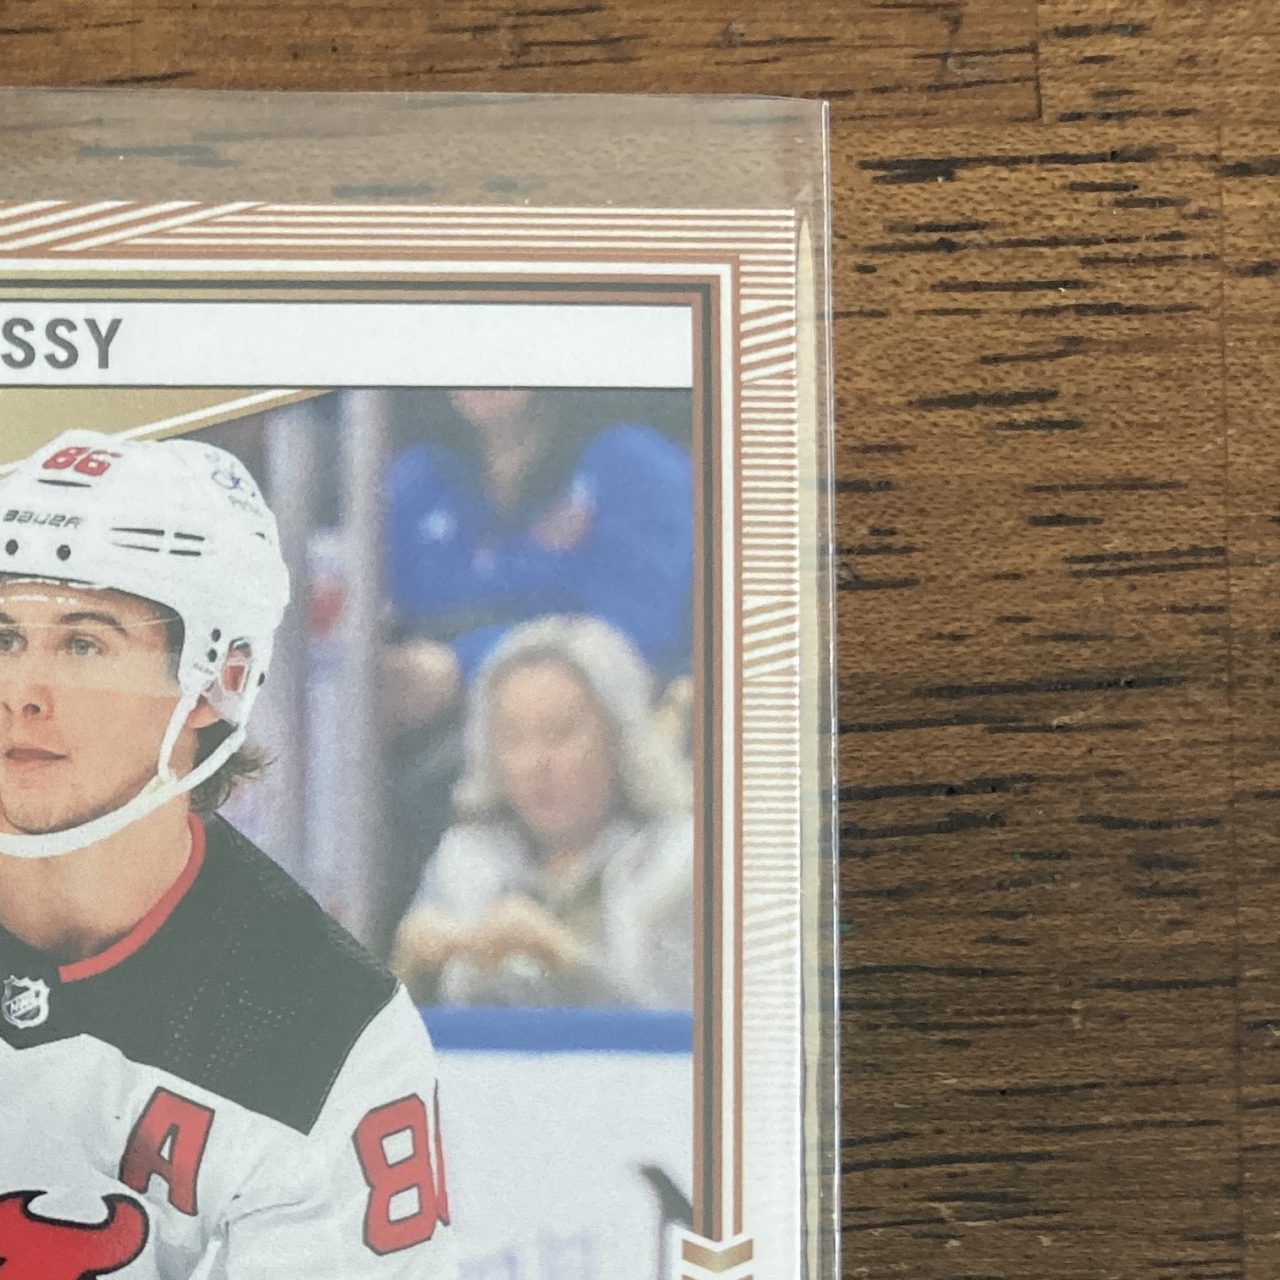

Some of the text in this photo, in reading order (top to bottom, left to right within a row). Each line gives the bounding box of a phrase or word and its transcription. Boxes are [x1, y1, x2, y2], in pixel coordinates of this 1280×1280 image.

[2, 508, 83, 530] BAUER
[118, 1085, 217, 1217] A
[351, 1078, 451, 1257] 8
